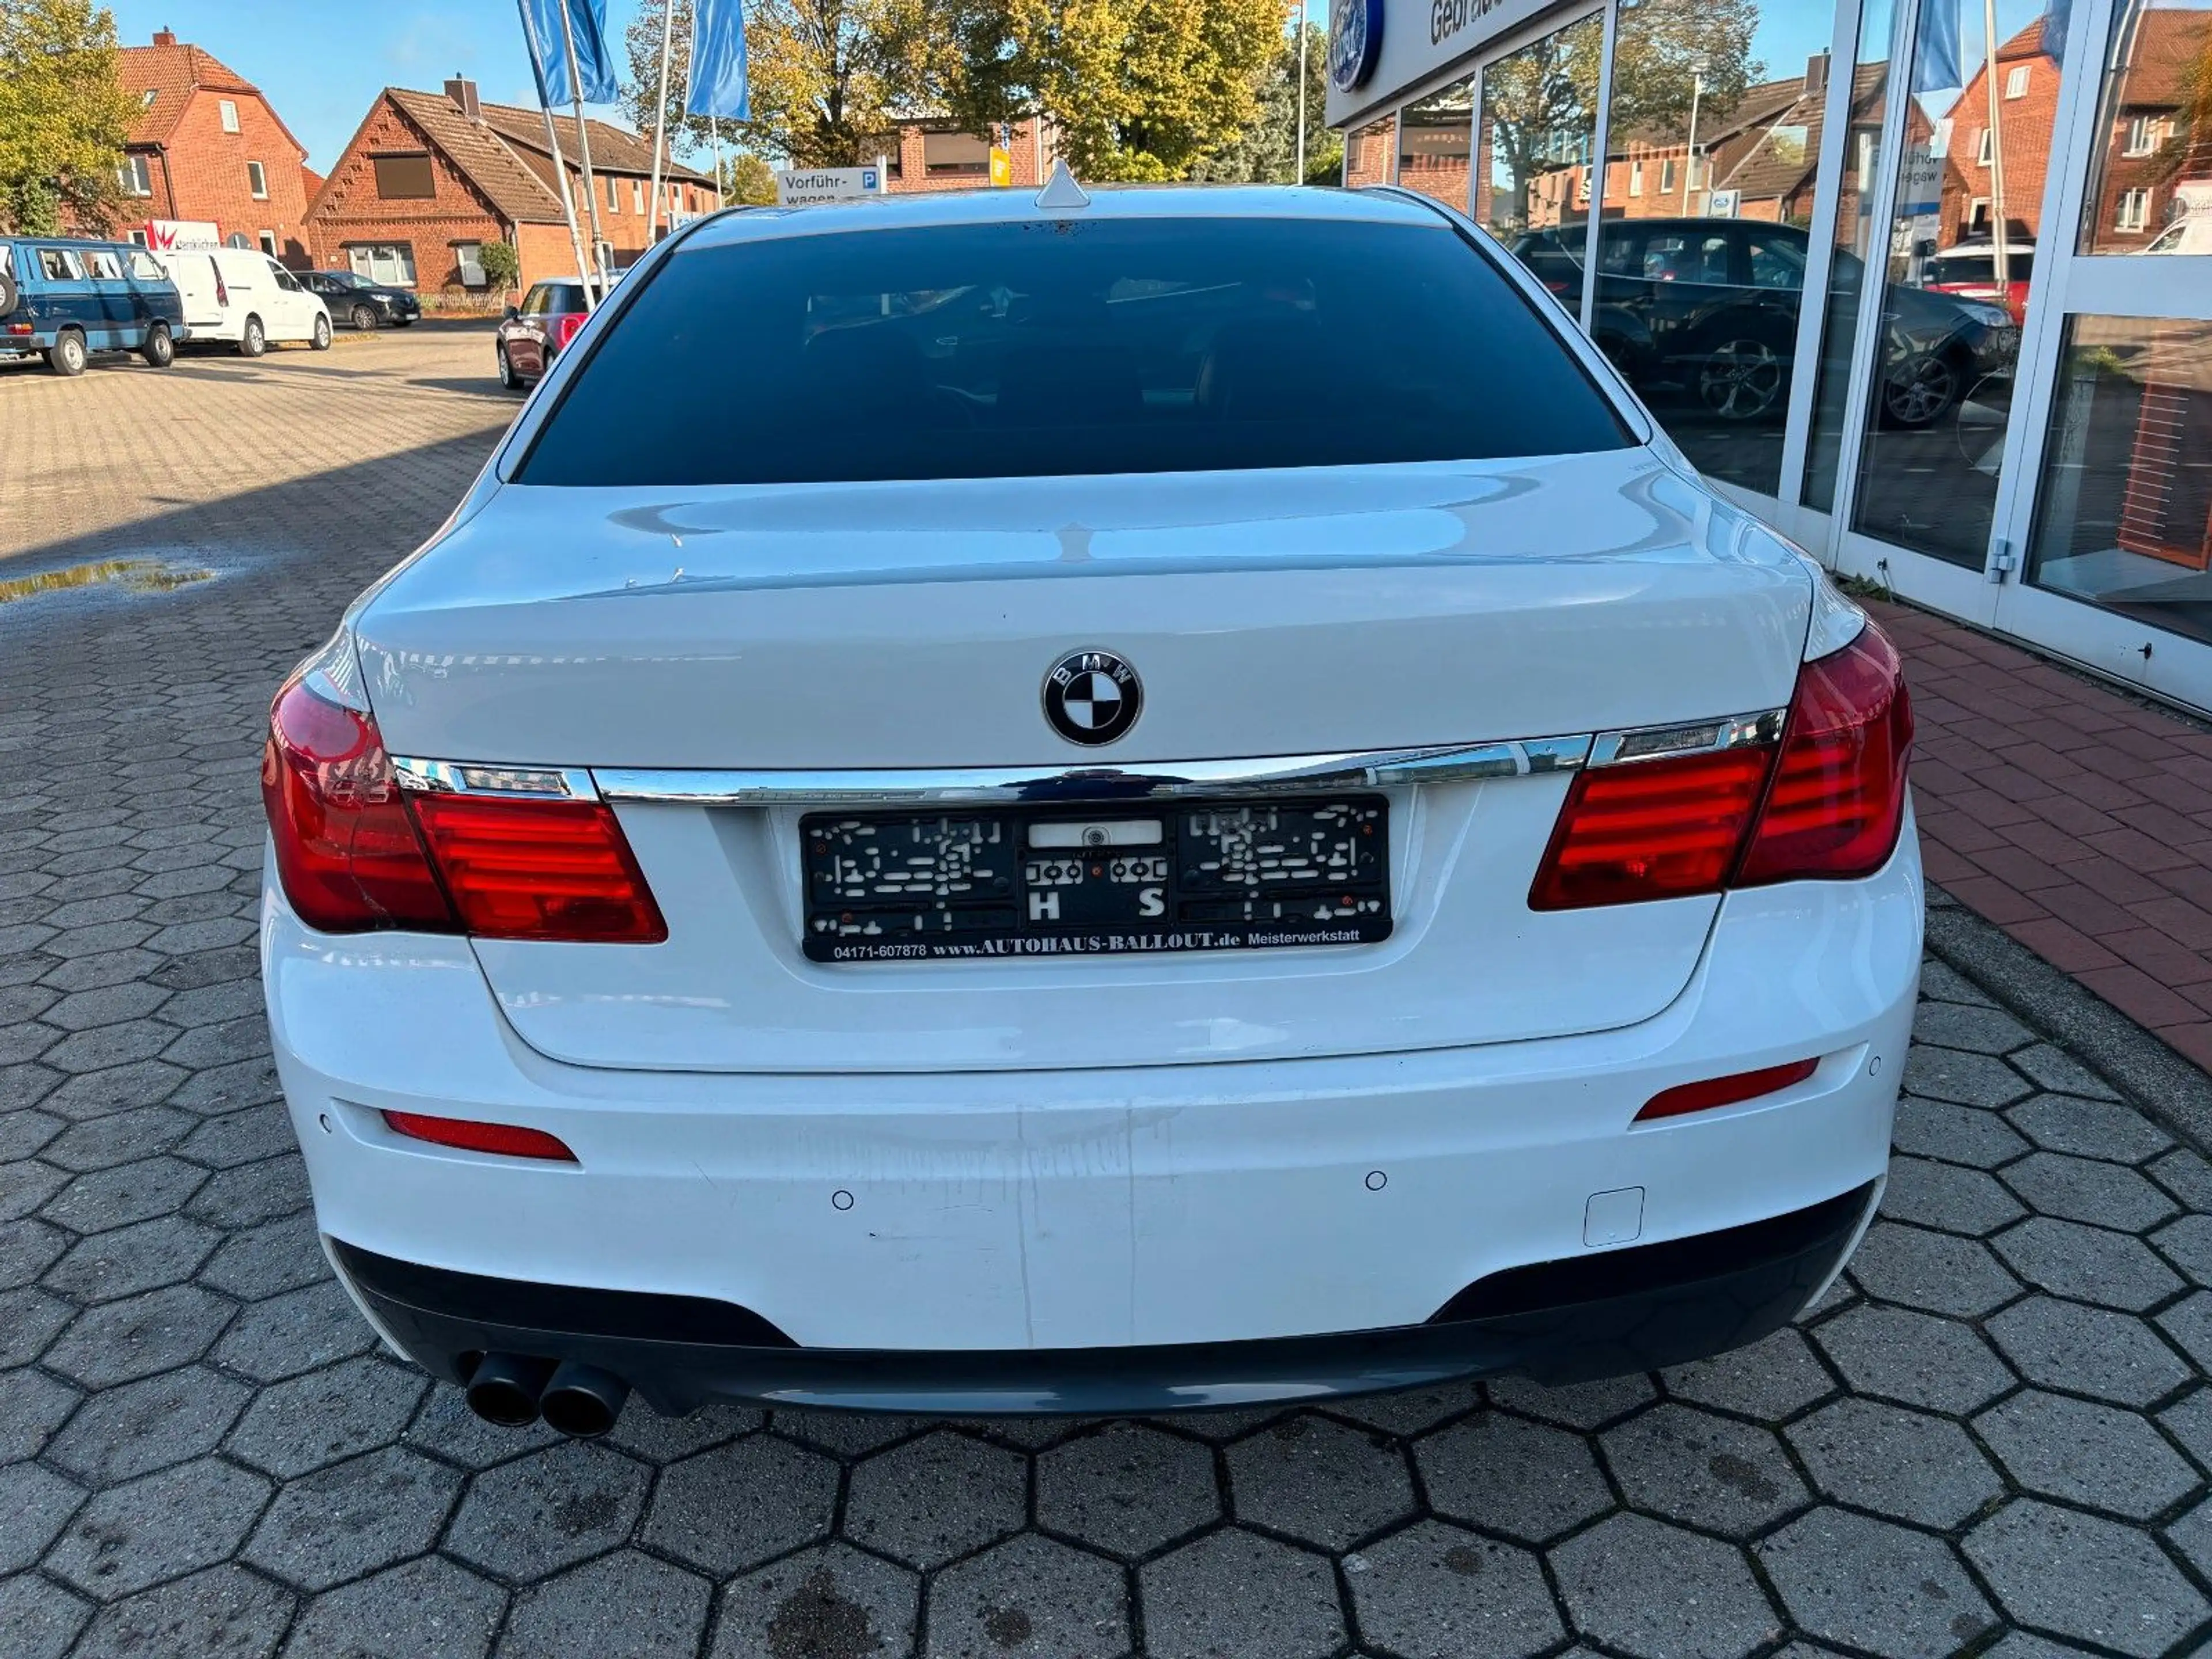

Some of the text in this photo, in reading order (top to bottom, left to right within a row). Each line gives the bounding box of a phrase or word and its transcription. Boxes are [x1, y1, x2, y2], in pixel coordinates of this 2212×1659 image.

[785, 175, 847, 189] Vorführ-
[1052, 654, 1132, 687] BMW
[835, 929, 1359, 959] 04171-607878 www.AUTOHAUS-BALLOUT.de Meisterwerkstatt
